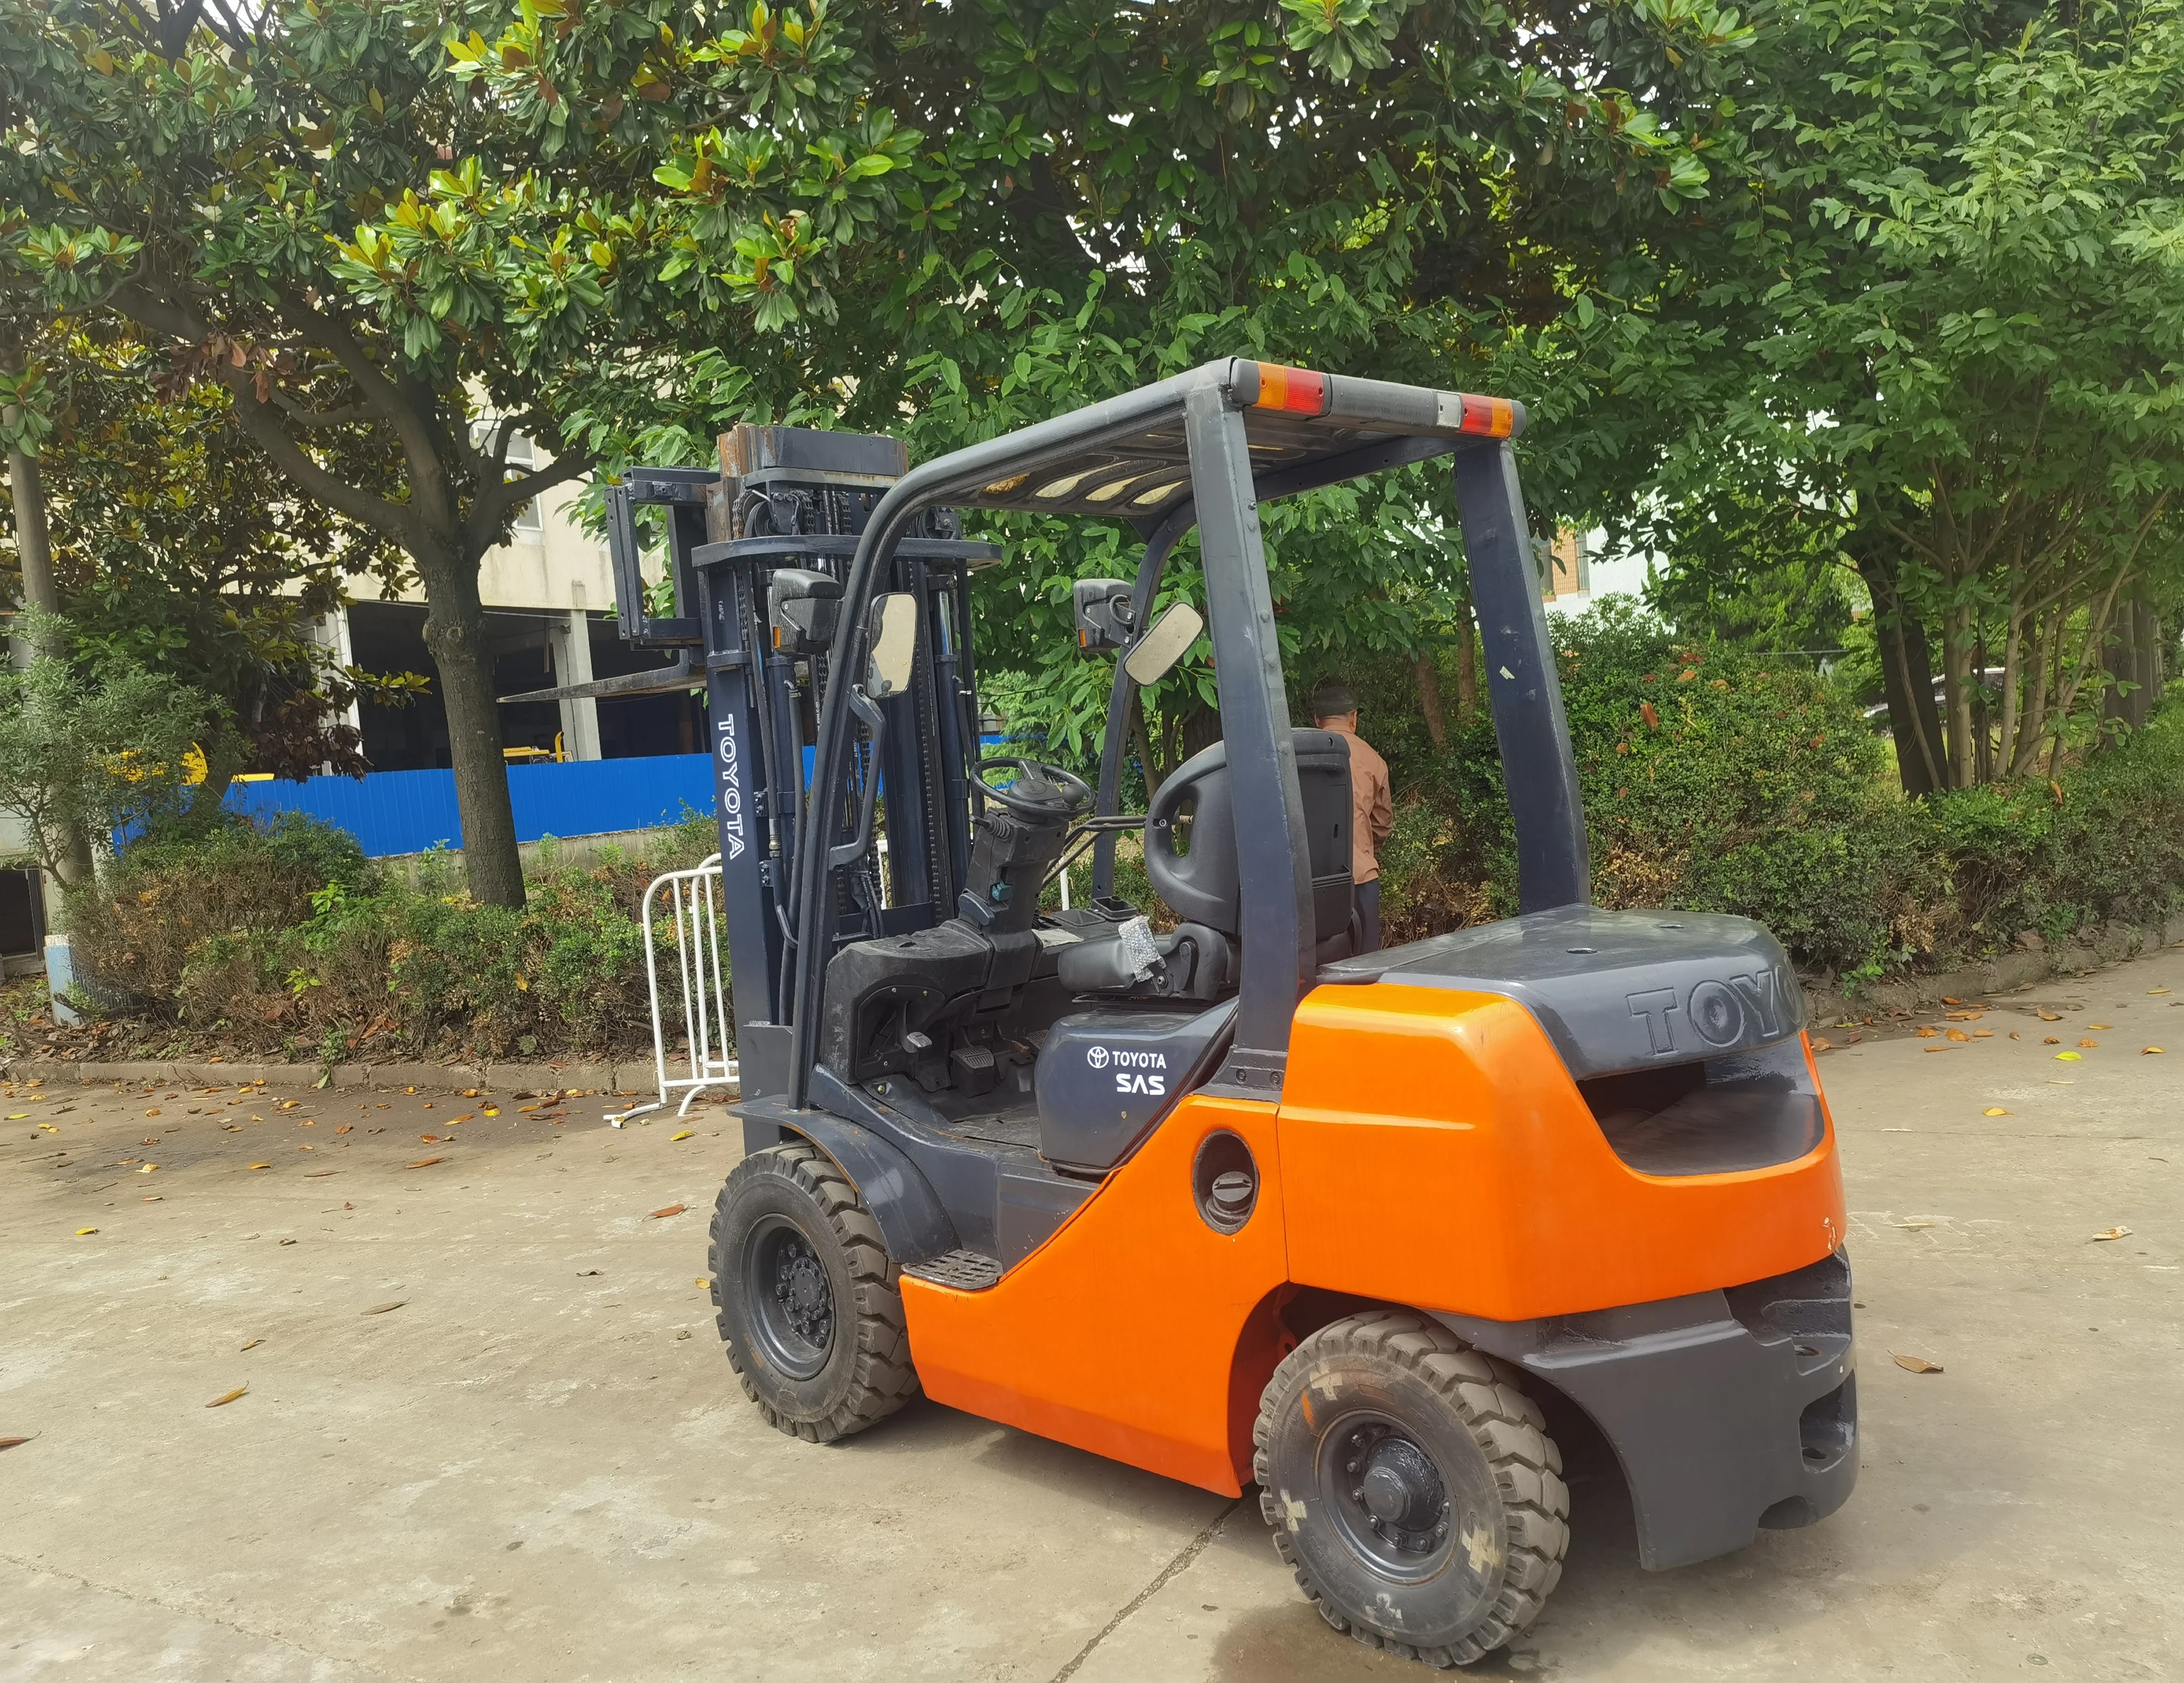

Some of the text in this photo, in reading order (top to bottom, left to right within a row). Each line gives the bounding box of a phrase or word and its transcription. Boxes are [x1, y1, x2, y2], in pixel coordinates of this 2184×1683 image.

[718, 713, 745, 860] TOYOTA
[1112, 1051, 1167, 1069] TOYOTA
[1116, 1073, 1165, 1095] SAS
